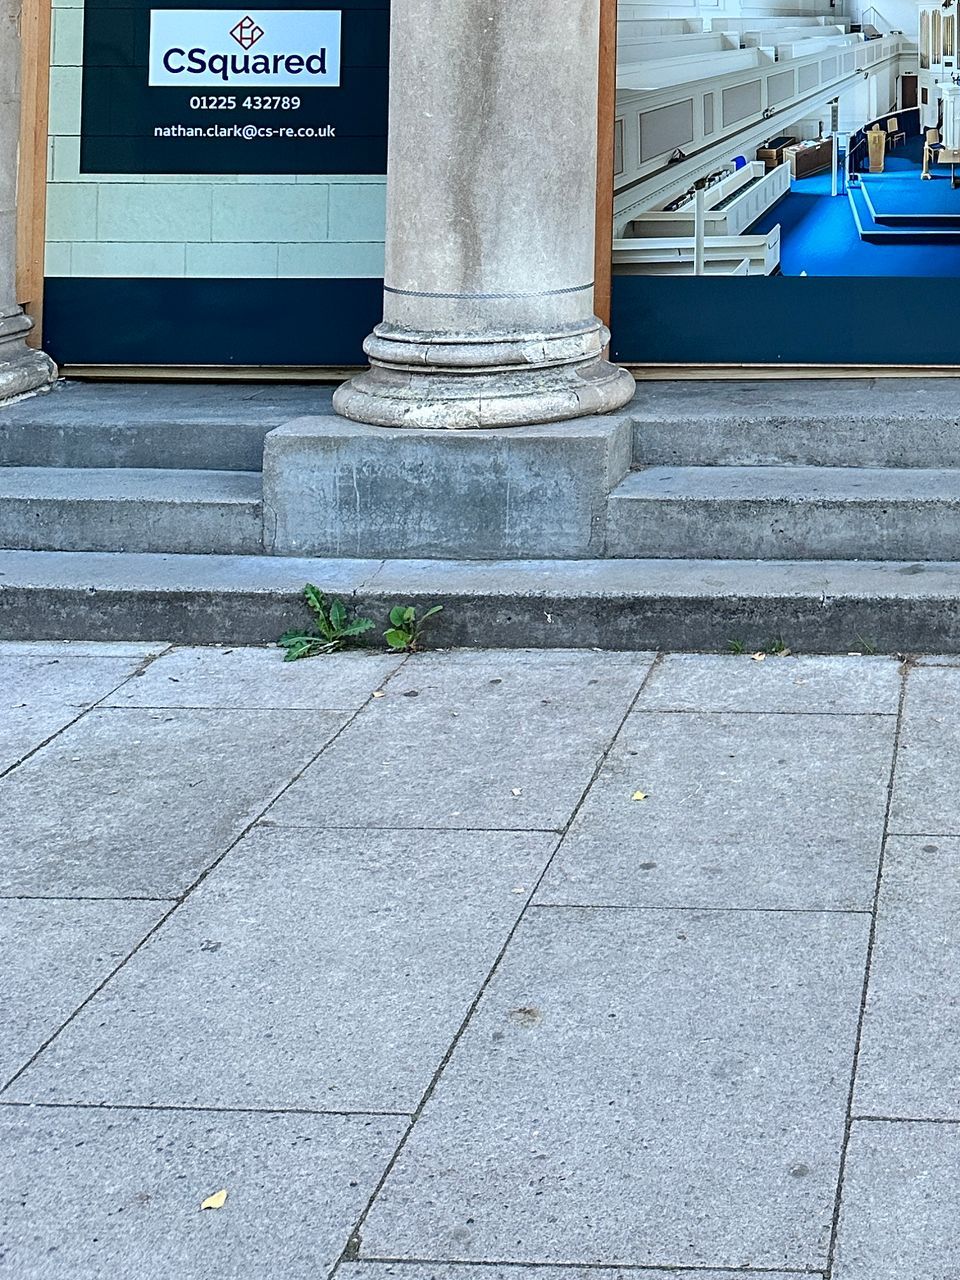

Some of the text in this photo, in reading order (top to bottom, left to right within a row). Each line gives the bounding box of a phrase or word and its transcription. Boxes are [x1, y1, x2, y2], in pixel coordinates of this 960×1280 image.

[162, 47, 327, 81] CSquared
[189, 96, 301, 110] 01225 432789
[154, 124, 336, 140] nathan.clark@cs-re.co.uk
